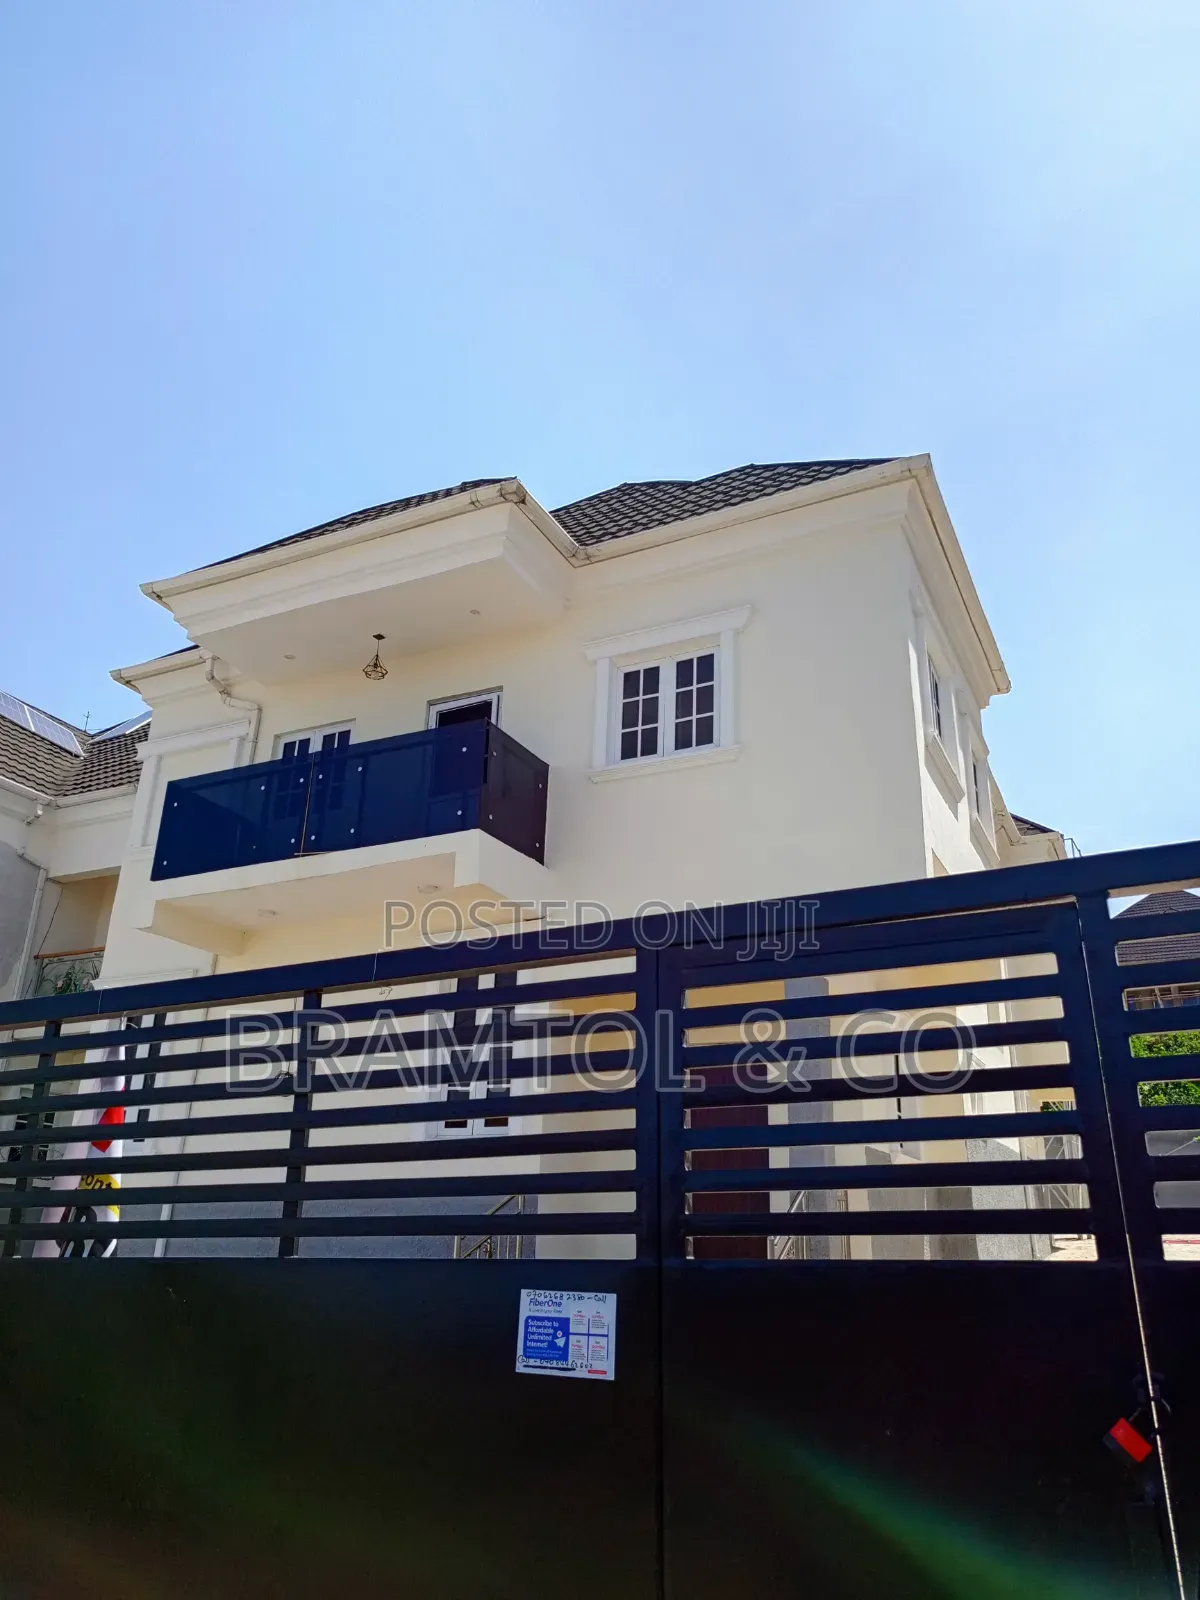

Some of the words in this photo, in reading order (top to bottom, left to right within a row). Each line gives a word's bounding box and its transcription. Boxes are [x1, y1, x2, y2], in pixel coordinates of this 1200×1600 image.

[528, 1298, 562, 1307] FiberOne
[528, 1319, 553, 1327] Subscribe
[527, 1333, 552, 1341] Unlimited
